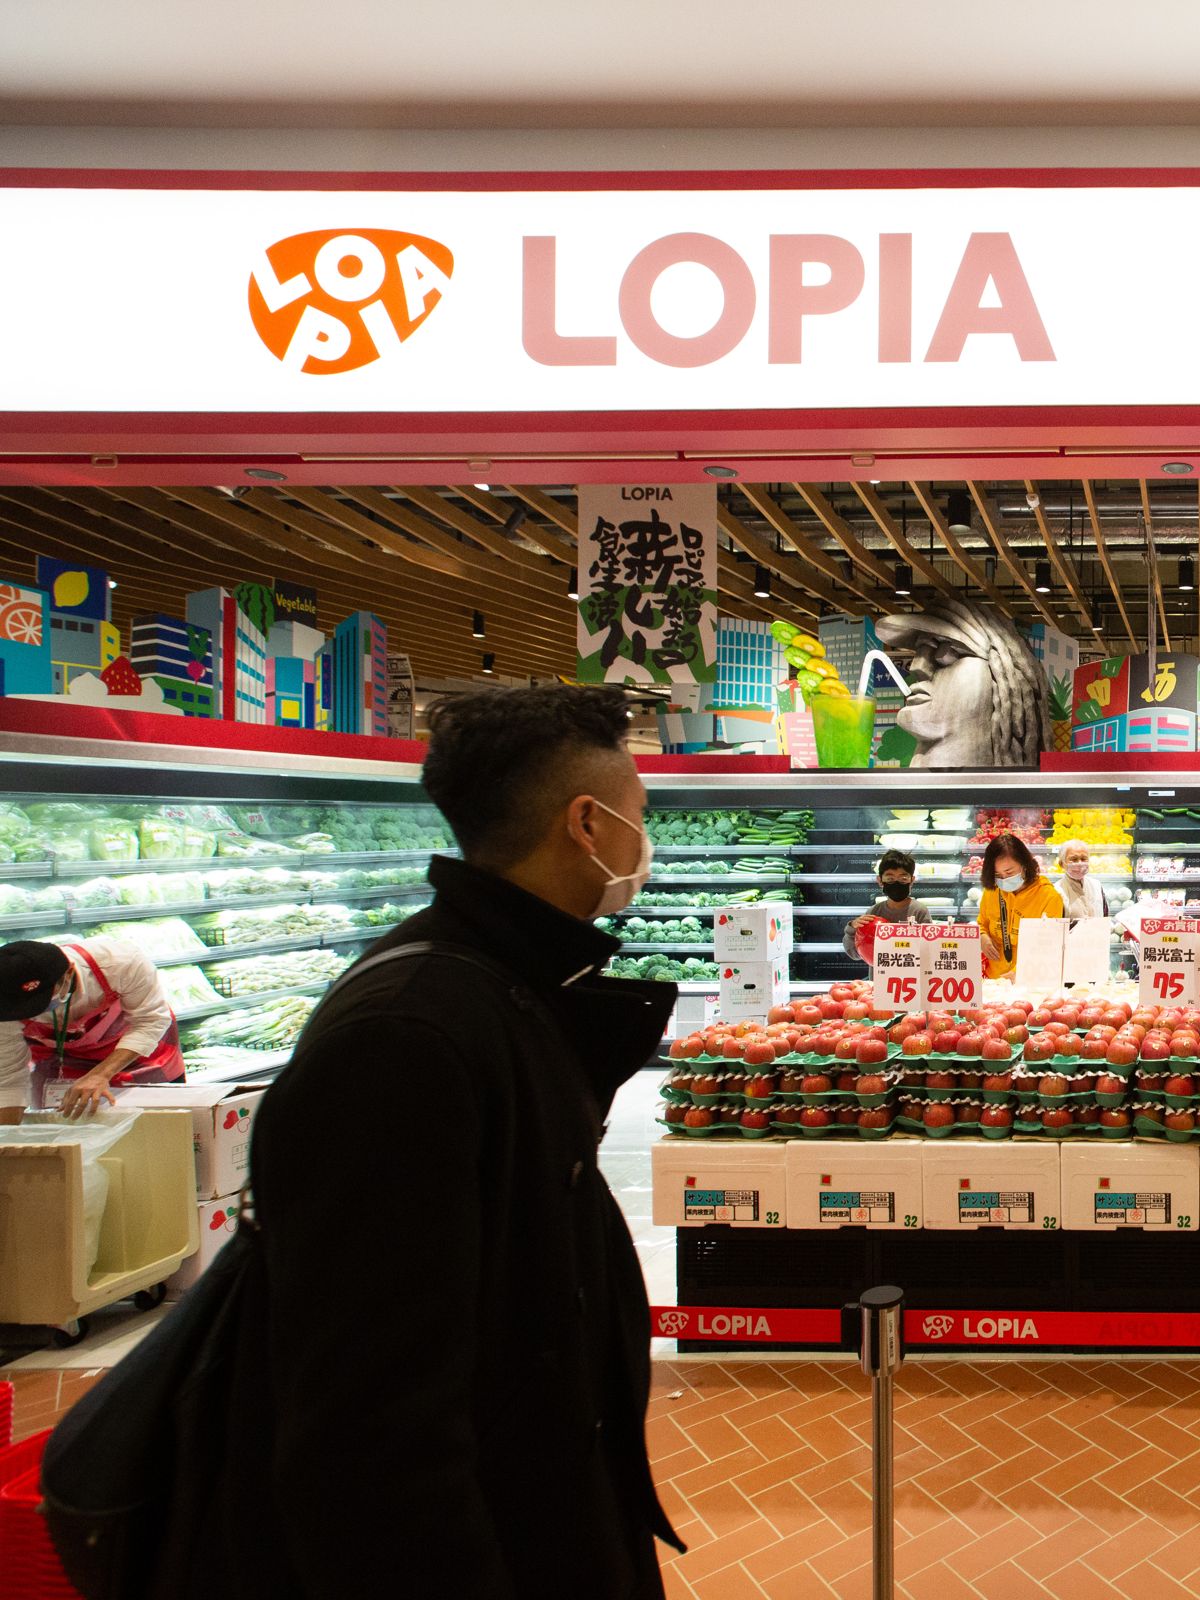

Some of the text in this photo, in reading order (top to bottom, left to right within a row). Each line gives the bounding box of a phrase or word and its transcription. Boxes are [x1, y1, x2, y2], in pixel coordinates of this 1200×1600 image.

[522, 231, 1057, 368] LOPIA
[621, 487, 673, 500] LOPIA
[275, 593, 316, 614] Vegetable
[943, 927, 978, 938] お買得
[940, 951, 958, 960] 蘋果
[1143, 947, 1195, 962] 陽光富士
[935, 961, 967, 970] 任選3個
[887, 977, 917, 1003] 75
[927, 977, 975, 1003] 200
[1153, 972, 1185, 998] 75
[766, 1212, 779, 1224] 32
[904, 1215, 918, 1228] 32
[1042, 1216, 1057, 1229] 32
[1177, 1216, 1191, 1228] 32
[698, 1314, 772, 1336] LOPIA
[963, 1317, 1039, 1339] LOPIA
